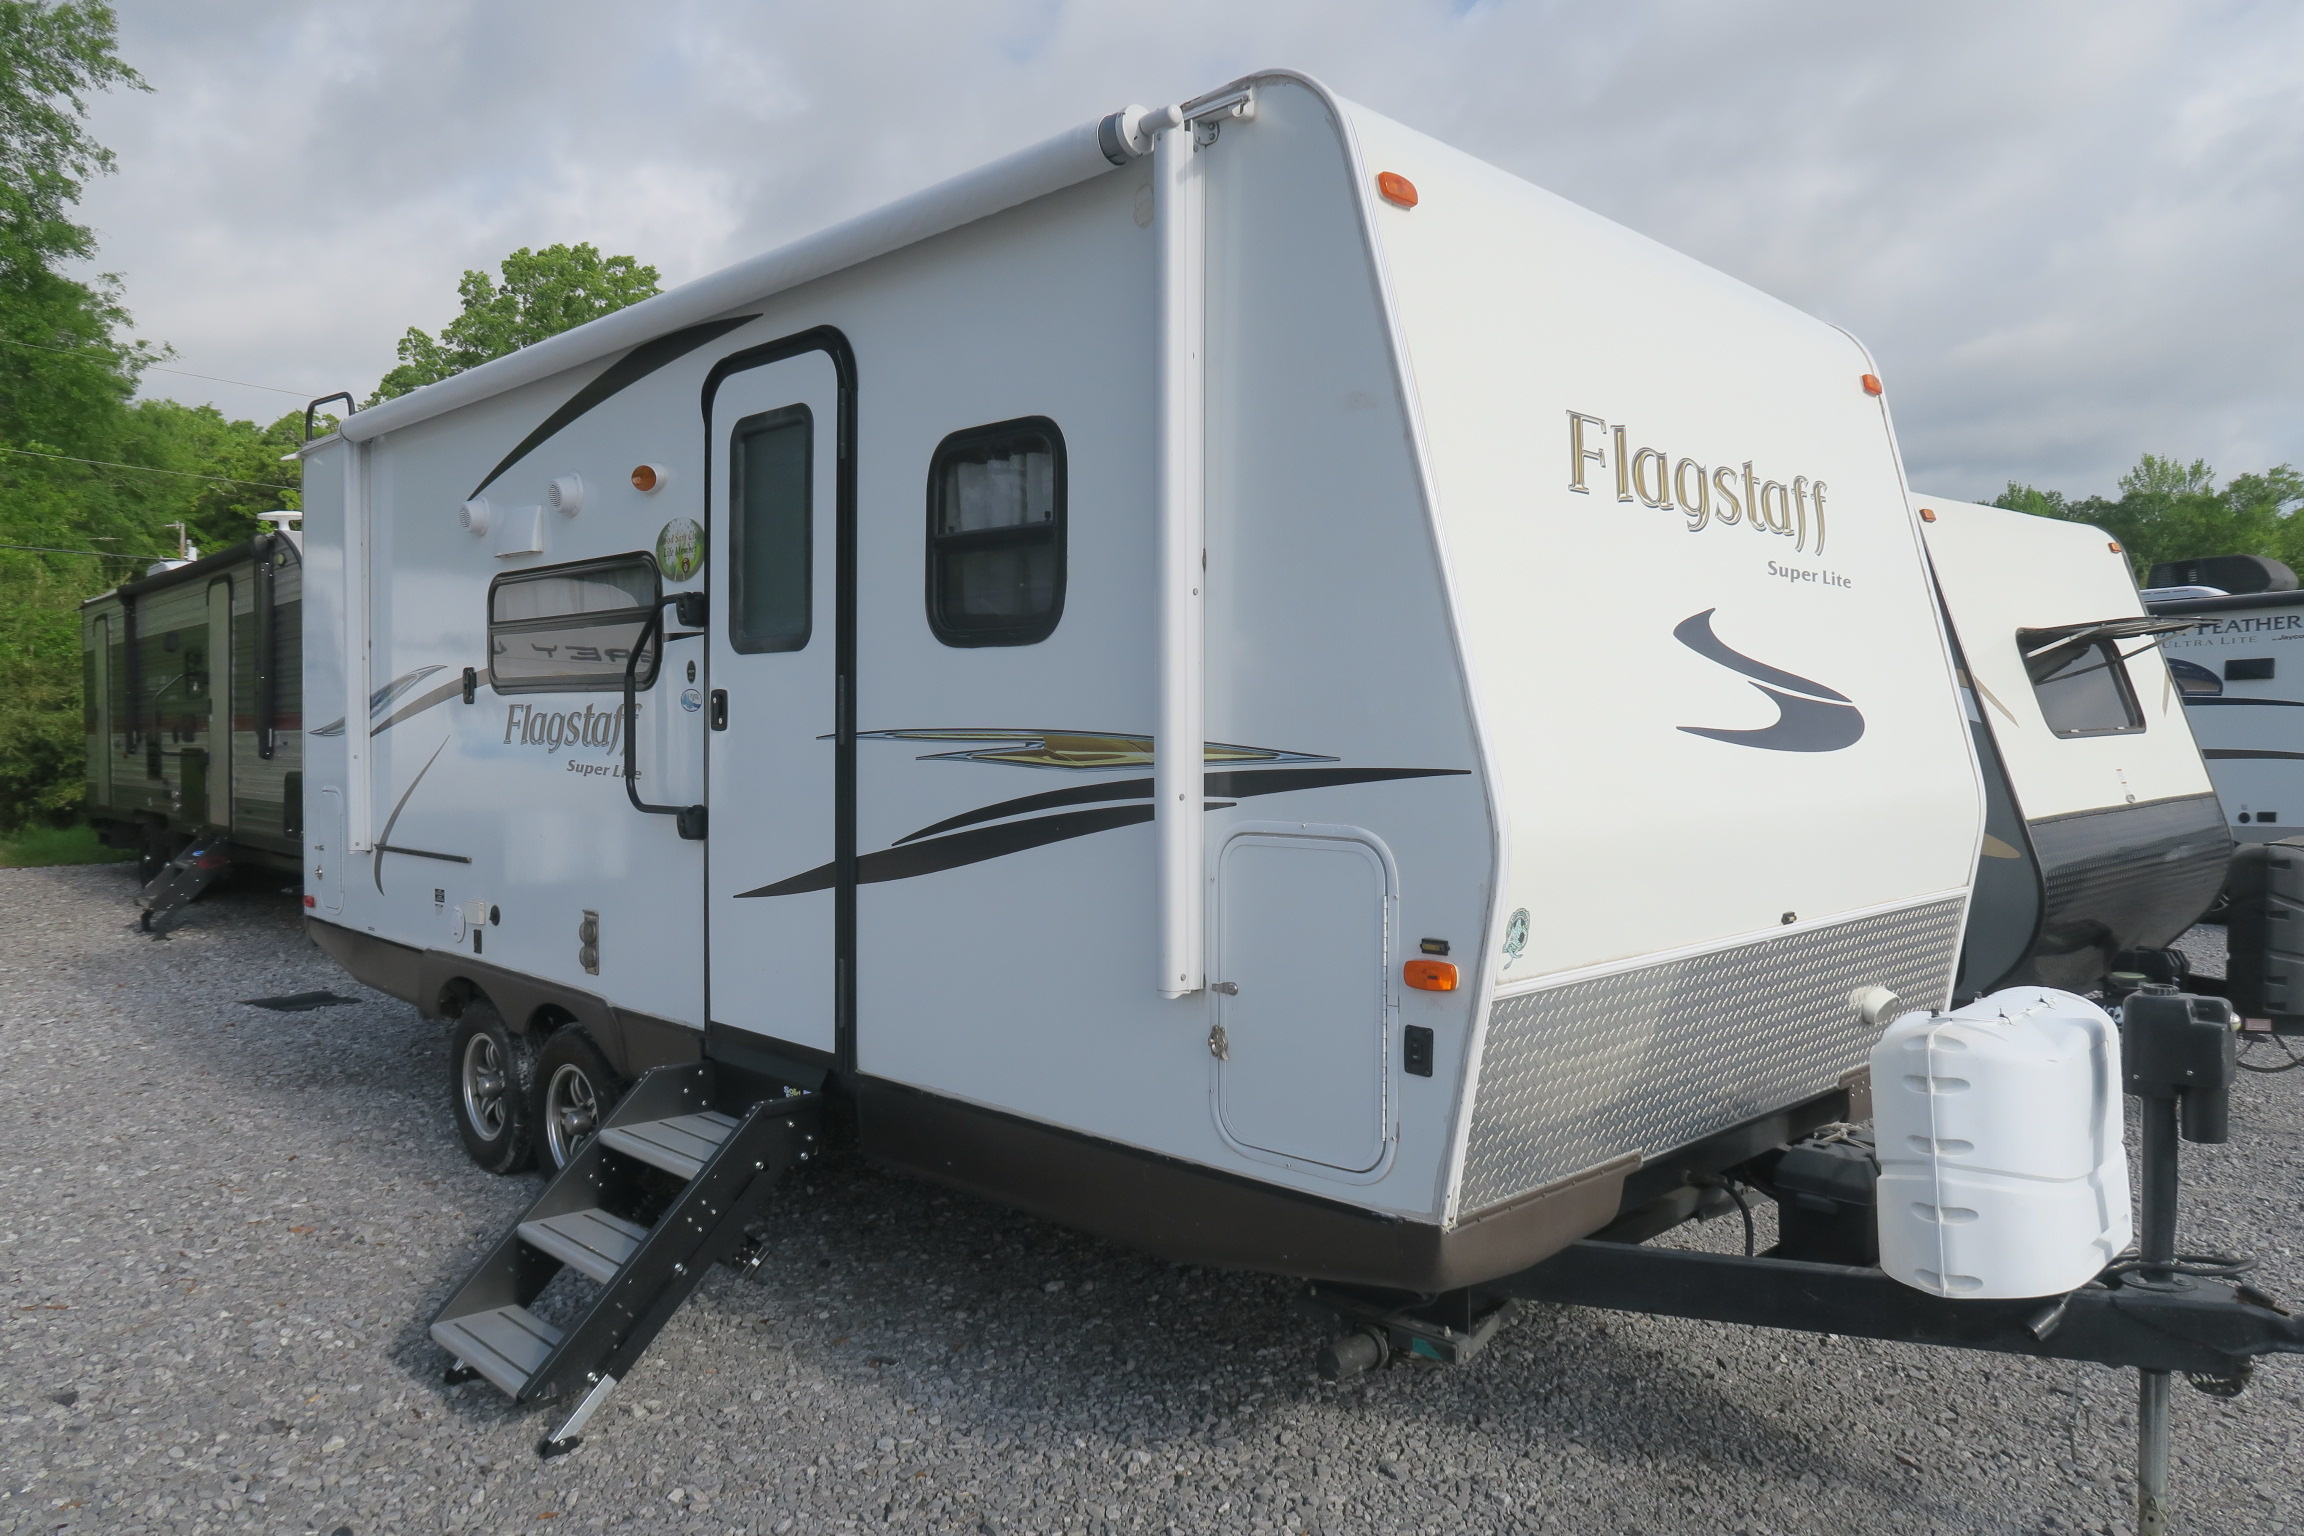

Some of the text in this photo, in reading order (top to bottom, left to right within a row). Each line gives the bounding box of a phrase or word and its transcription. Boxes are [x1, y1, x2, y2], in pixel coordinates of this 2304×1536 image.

[1565, 409, 1828, 556] Flagstaff
[1767, 559, 1852, 590] Super Lite
[566, 759, 642, 780] Super Lie
